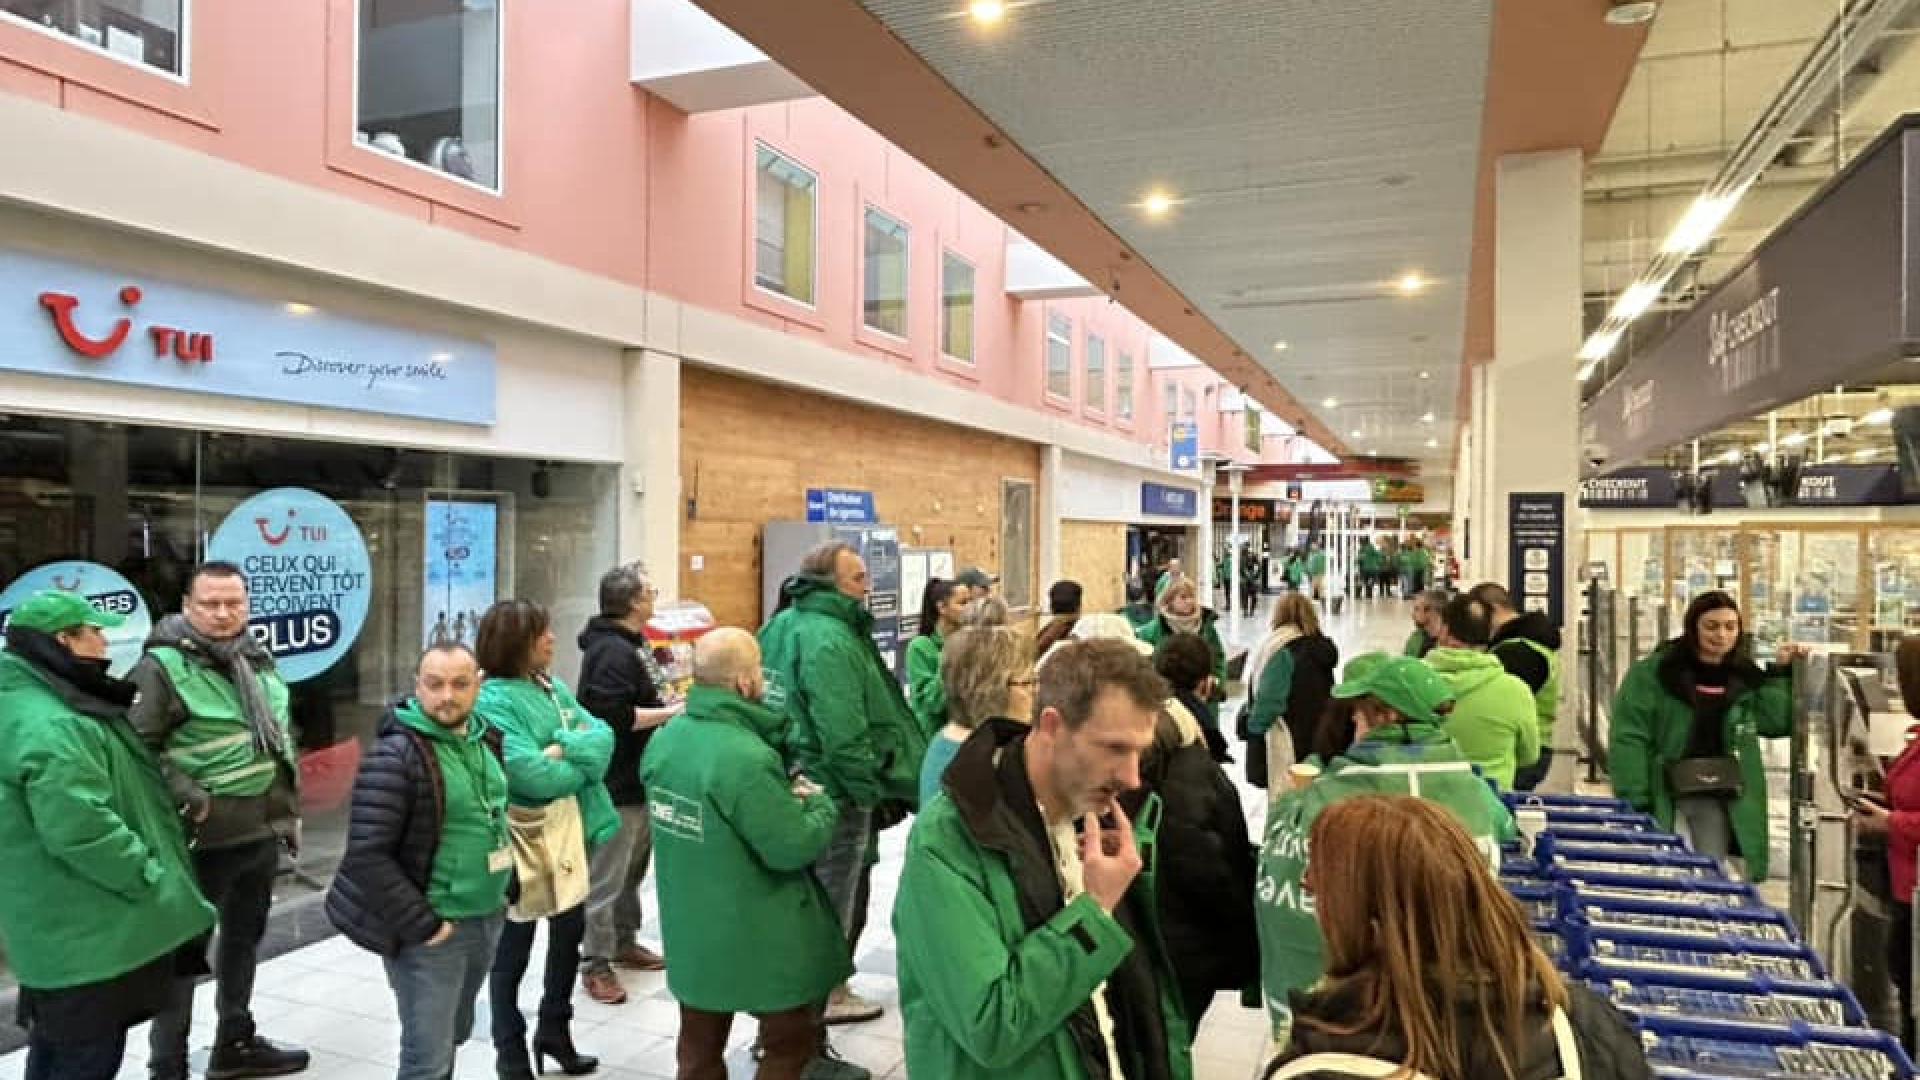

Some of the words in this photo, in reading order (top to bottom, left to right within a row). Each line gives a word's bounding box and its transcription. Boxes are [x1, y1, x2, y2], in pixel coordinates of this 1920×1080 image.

[149, 326, 214, 363] TUI
[301, 525, 328, 541] TUI
[245, 555, 299, 574] CEUX
[303, 555, 337, 576] QUI
[246, 574, 324, 594] ERVENT
[249, 613, 332, 651] PLUS
